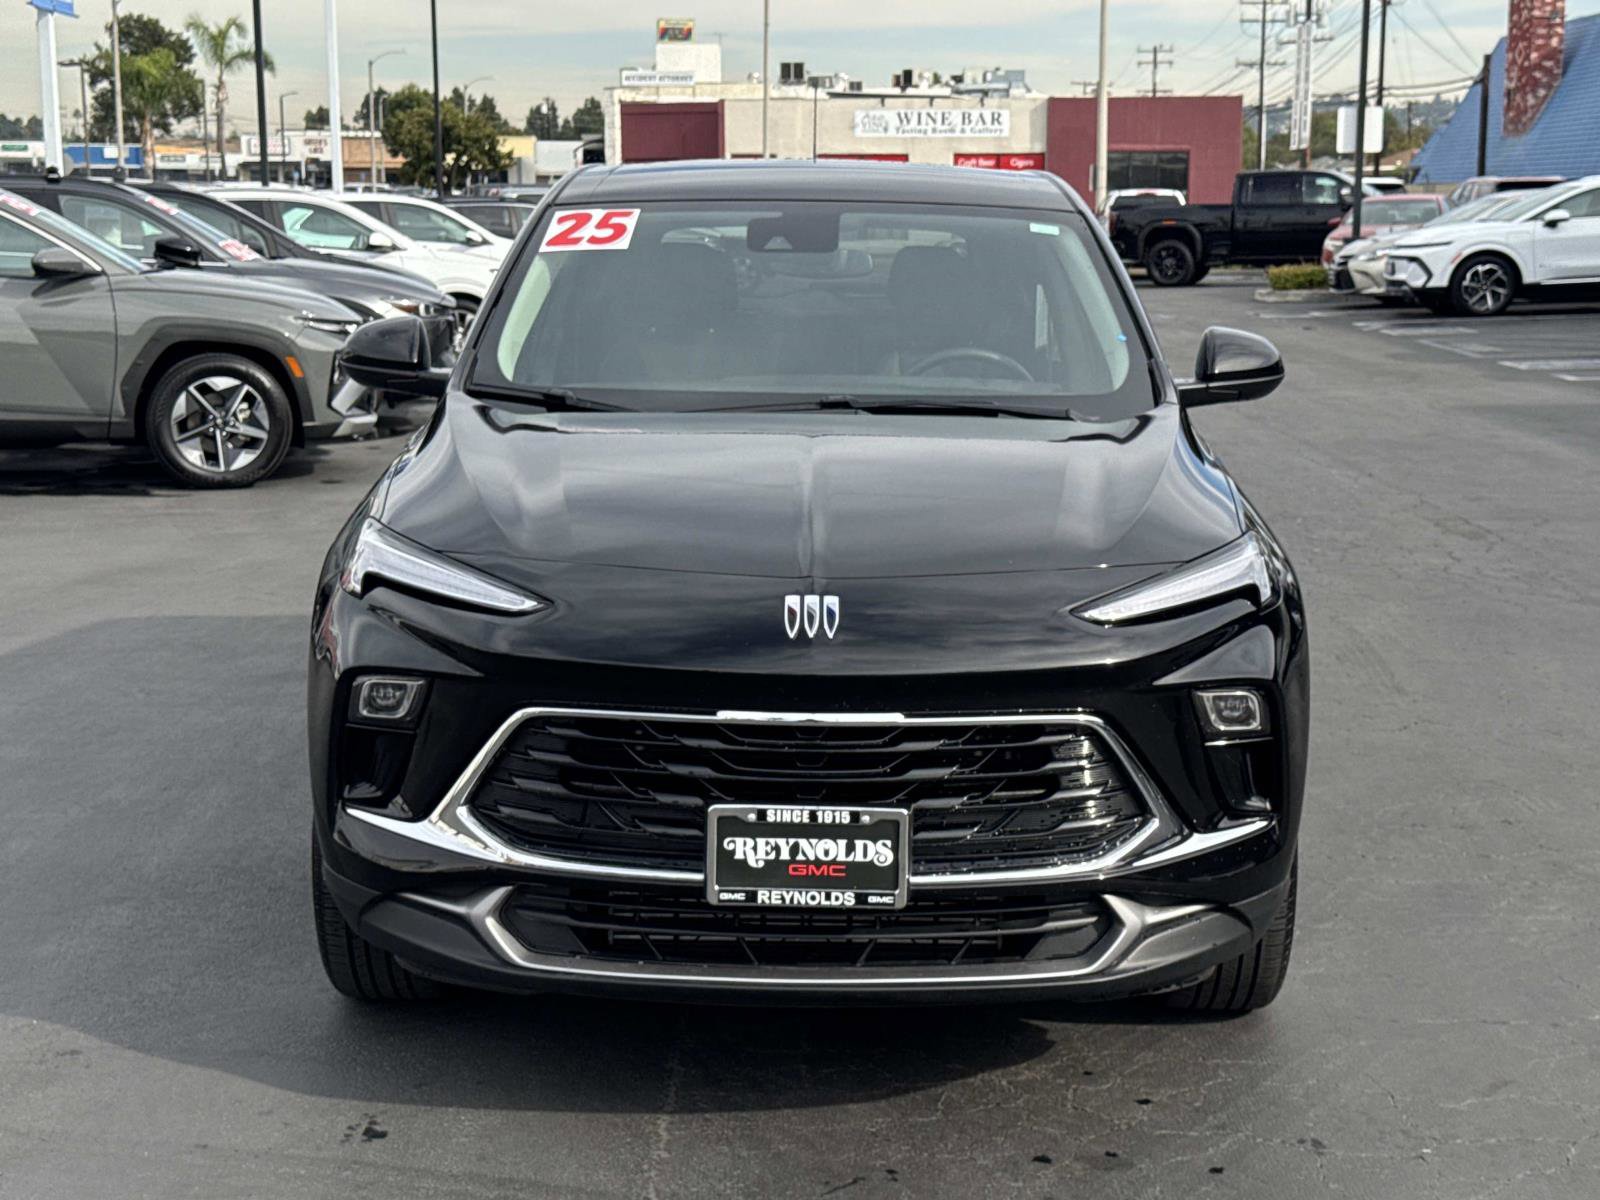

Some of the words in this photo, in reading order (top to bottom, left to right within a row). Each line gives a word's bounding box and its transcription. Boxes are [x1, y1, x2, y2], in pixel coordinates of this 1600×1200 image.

[895, 111, 953, 126] WINE
[961, 111, 1003, 126] BAR
[545, 211, 634, 247] 25
[766, 809, 810, 823] SINCE
[816, 810, 850, 824] 1915
[723, 837, 894, 868] REYNOLDS
[788, 864, 847, 877] GMC
[719, 892, 746, 900] GMC
[757, 890, 855, 906] REYNOLDS
[867, 895, 895, 904] GMC
